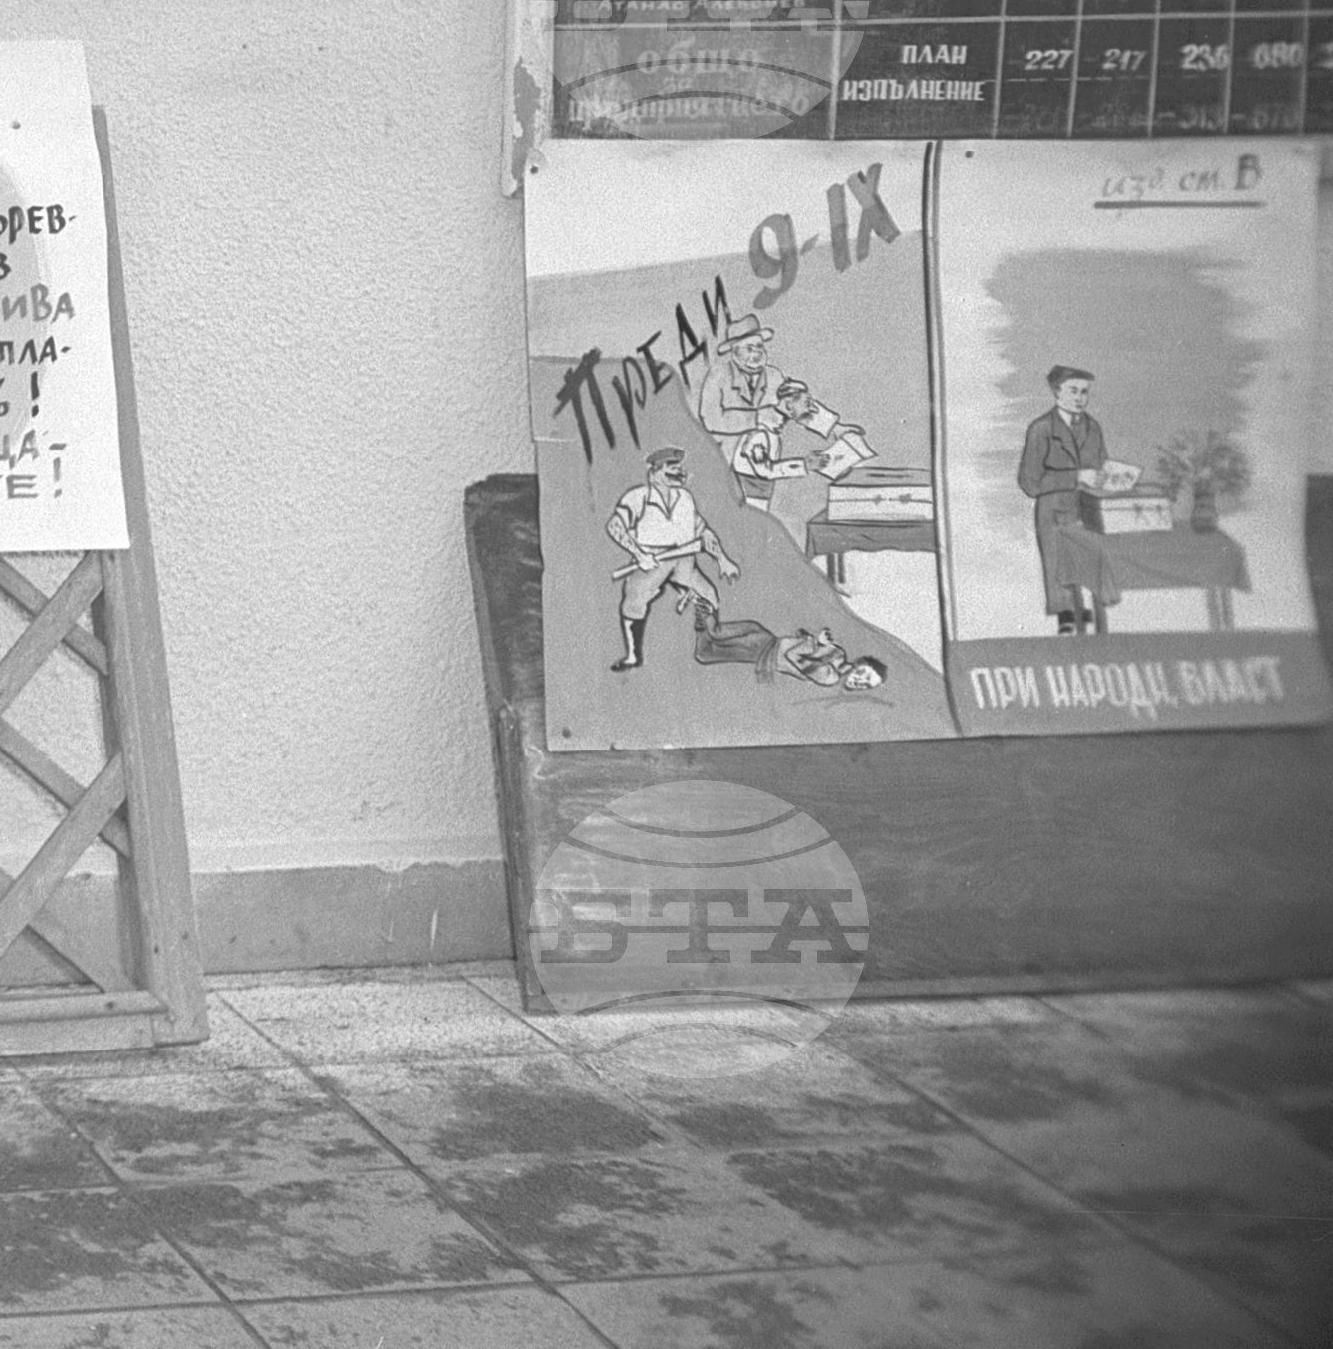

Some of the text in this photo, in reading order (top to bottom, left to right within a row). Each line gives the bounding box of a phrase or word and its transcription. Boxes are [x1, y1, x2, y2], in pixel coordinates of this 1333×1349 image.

[901, 44, 968, 64] ПЛАН
[1025, 49, 1074, 70] 227
[843, 79, 985, 101] ИЗПЪЛНЕНИЕ
[969, 664, 1041, 709] ПРИ
